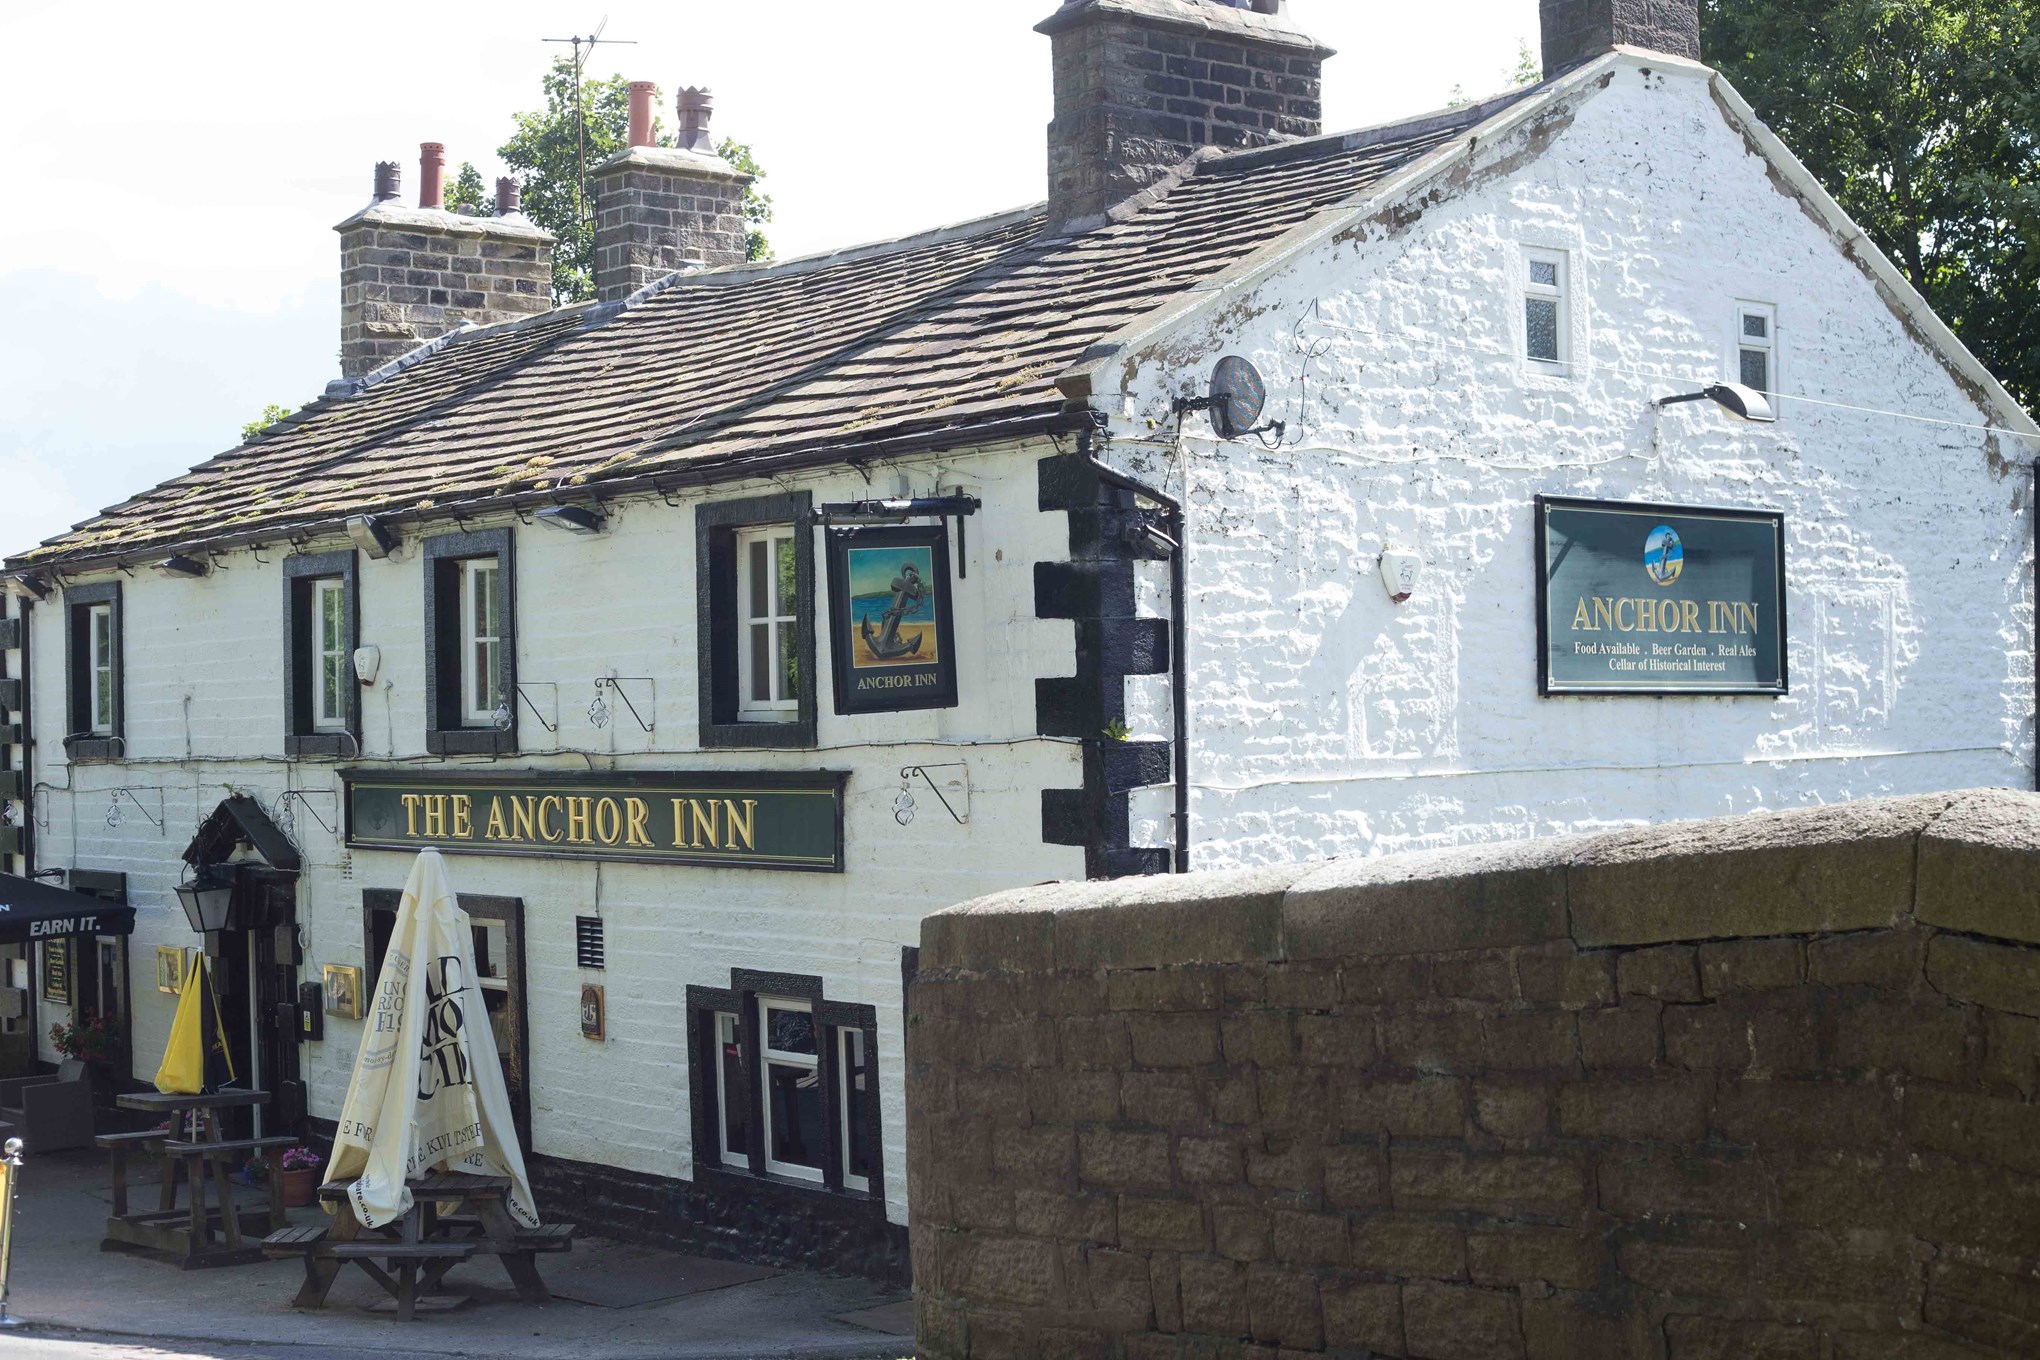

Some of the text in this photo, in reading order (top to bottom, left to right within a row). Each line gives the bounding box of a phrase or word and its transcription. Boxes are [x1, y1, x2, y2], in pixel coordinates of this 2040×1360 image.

[1571, 596, 1759, 635] ANCHOR INN
[1574, 641, 1757, 657] Food Available Beer Garden Real Ales
[1609, 658, 1726, 672] Cellar of Historical Interest
[857, 673, 937, 690] ANCHOR INN
[401, 794, 758, 851] THE ANCHOR INN
[30, 916, 100, 937] EARN IT.
[426, 956, 474, 1004] LD
